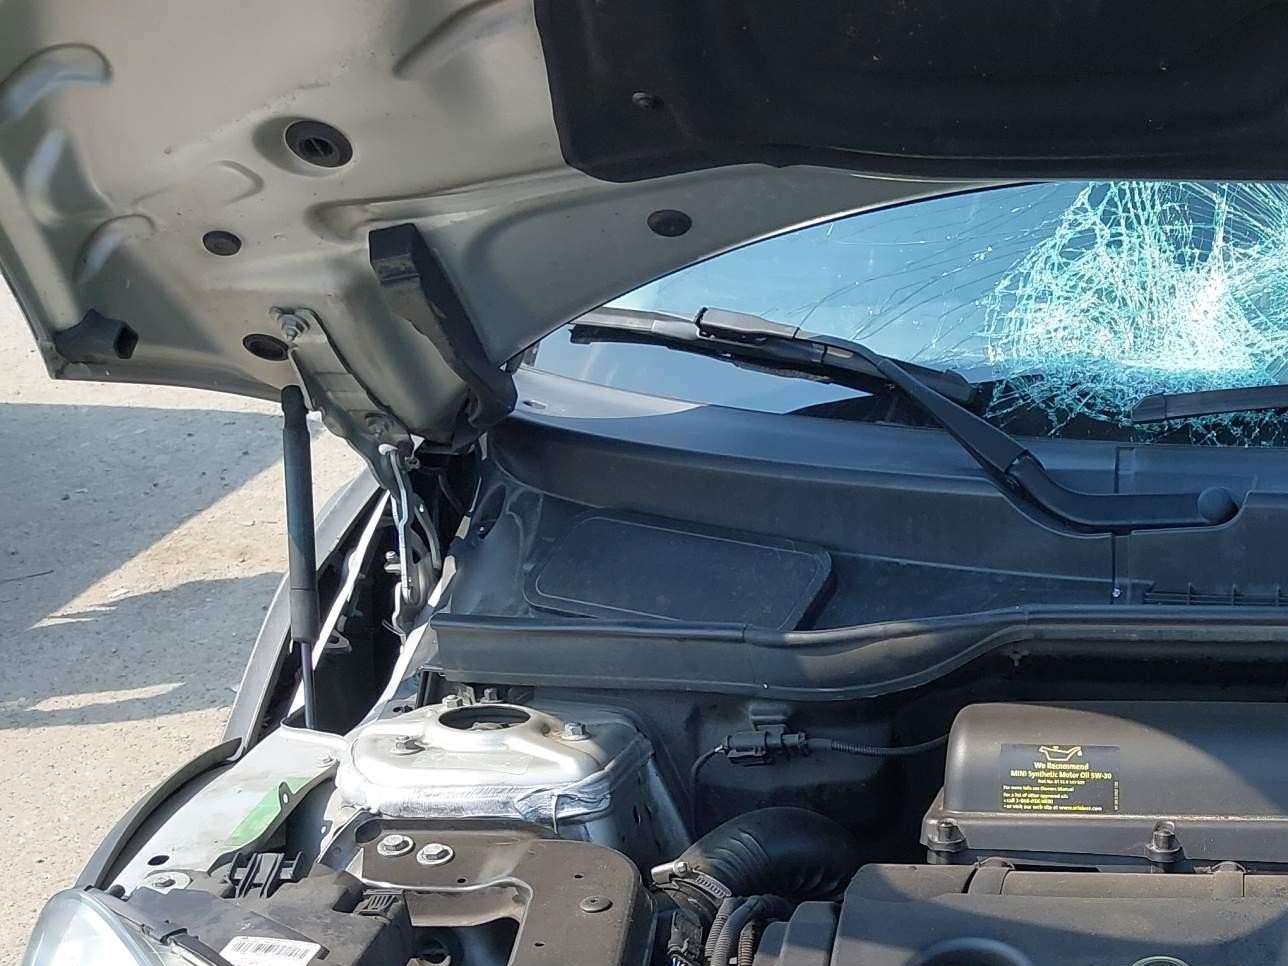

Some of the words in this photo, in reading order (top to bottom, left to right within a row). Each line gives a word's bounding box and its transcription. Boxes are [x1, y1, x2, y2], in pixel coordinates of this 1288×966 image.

[1034, 761, 1046, 769] We
[1046, 762, 1089, 770] Recommend
[1028, 770, 1058, 779] Synthetic
